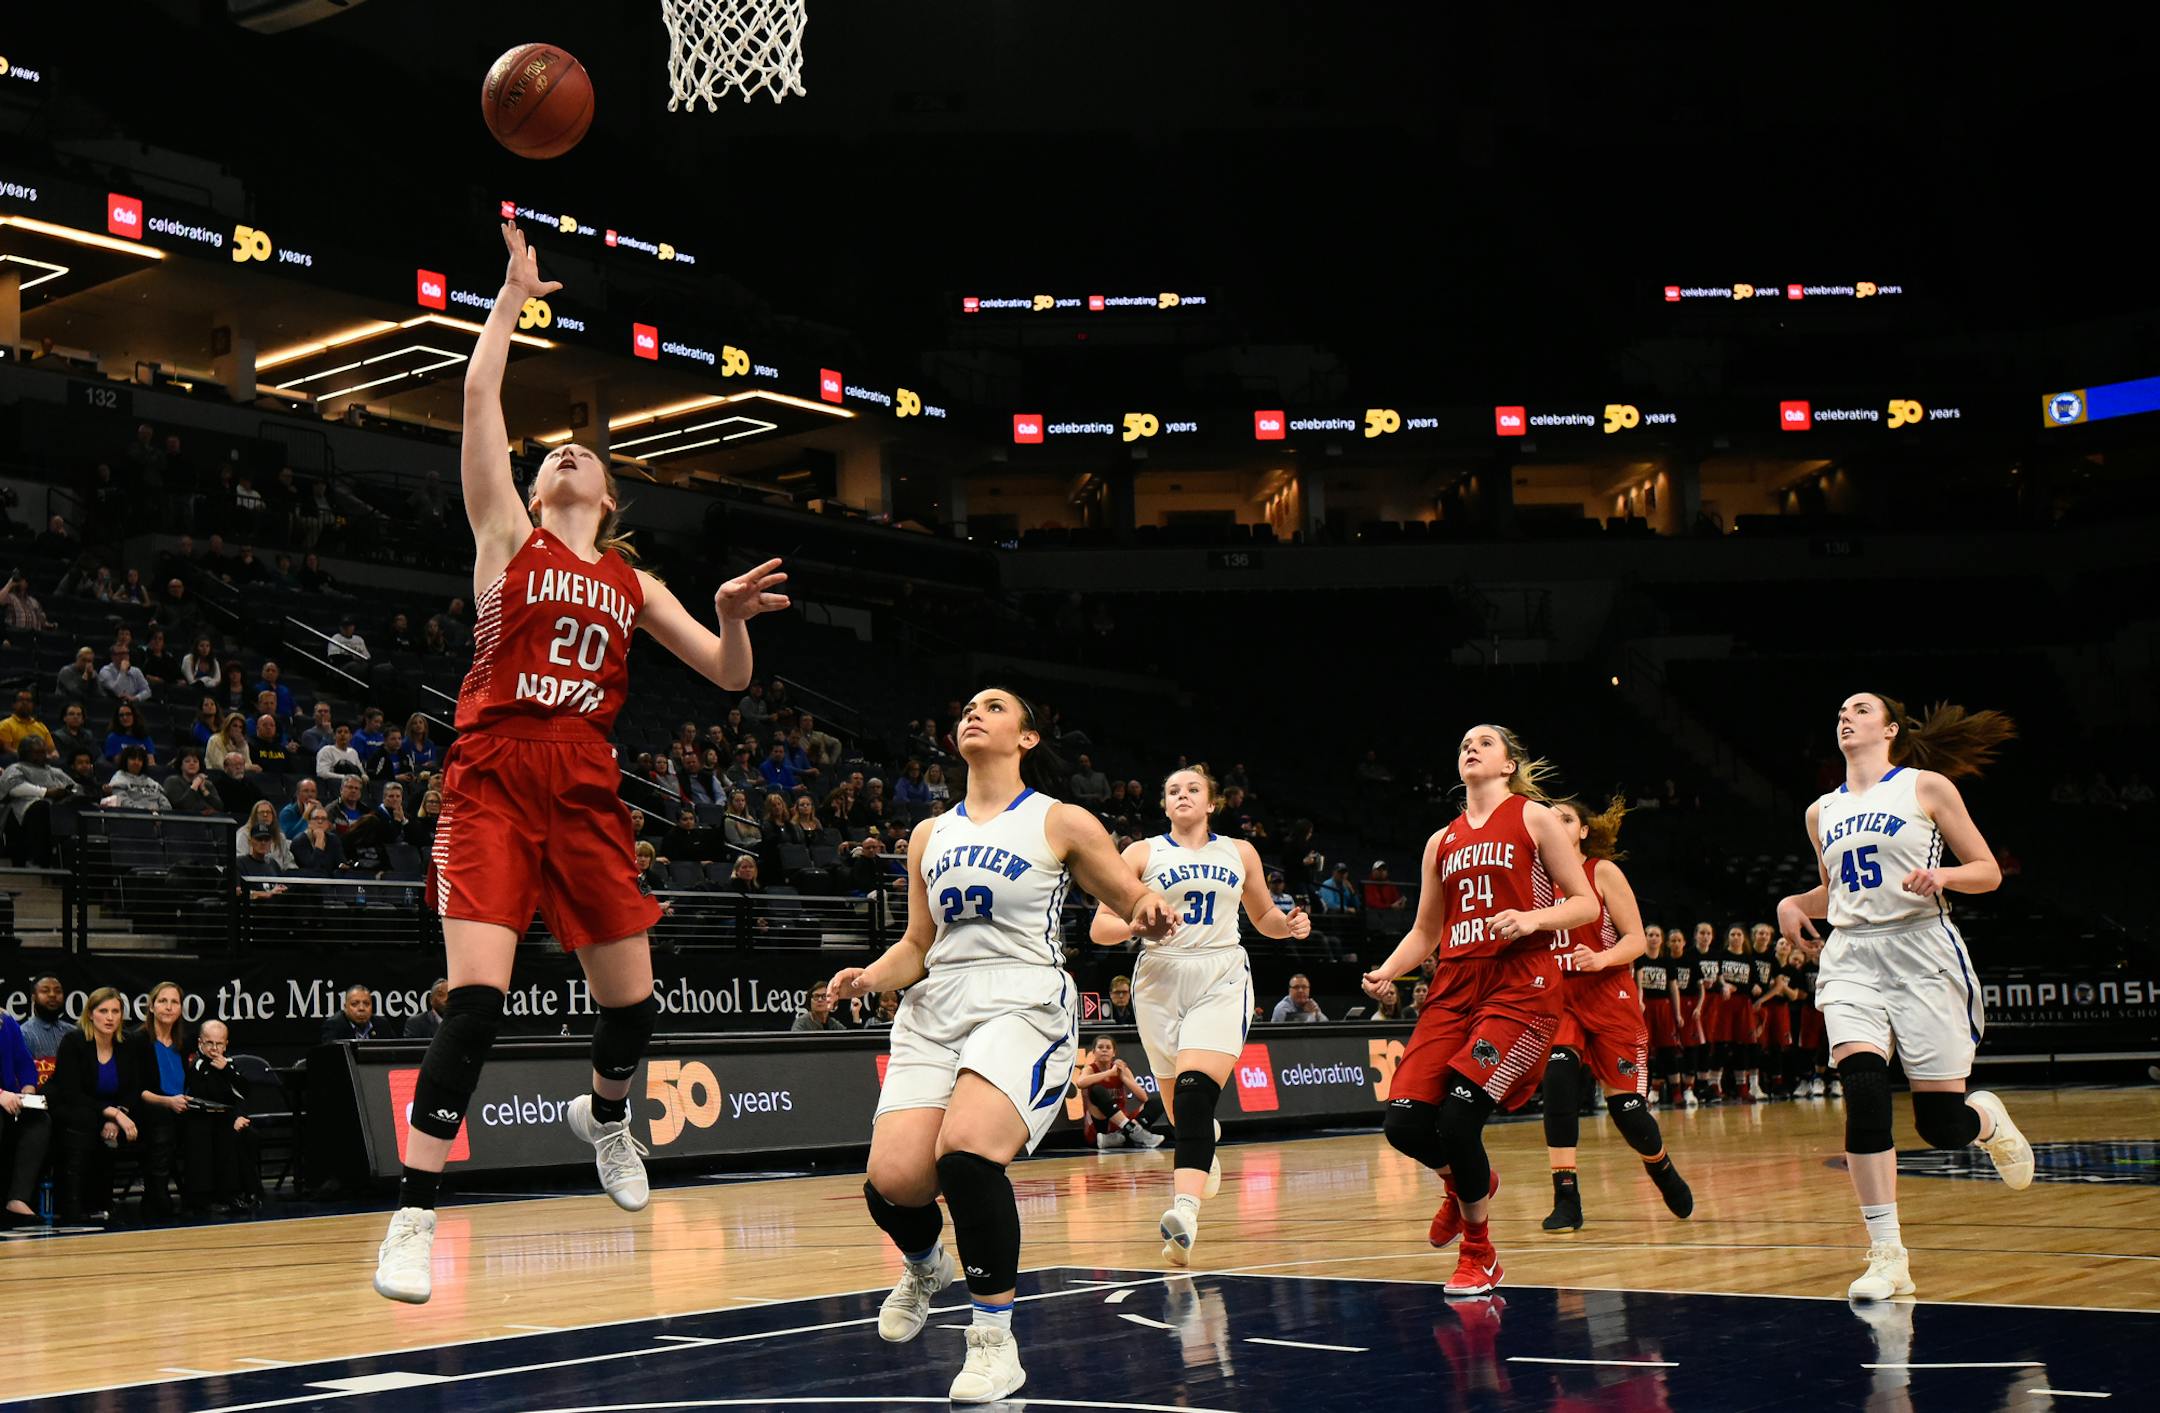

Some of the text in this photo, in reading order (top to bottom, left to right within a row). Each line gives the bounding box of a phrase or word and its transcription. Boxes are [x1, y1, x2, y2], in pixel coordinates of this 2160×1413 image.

[11, 66, 39, 82] years
[0, 181, 37, 201] years
[113, 207, 312, 266] Cub celebrating 50 years
[617, 236, 658, 255] celebrating
[657, 243, 675, 260] 50
[676, 253, 695, 264] years
[980, 299, 1032, 308] celebrating
[1033, 295, 1054, 311] 50
[1056, 299, 1081, 308] years
[1105, 297, 1157, 306] celebrating
[1159, 293, 1179, 309] 50
[1181, 297, 1206, 305] years
[1680, 288, 1731, 297] celebrating
[1733, 284, 1753, 300] 50
[1755, 288, 1779, 297] years
[1803, 286, 1854, 295] celebrating
[1856, 282, 1876, 298] 50
[1878, 286, 1902, 295] years
[422, 282, 441, 298] Cub
[451, 291, 499, 311] celebrat
[557, 317, 584, 331] years
[662, 342, 714, 365] celebrating
[722, 346, 750, 377] 50
[754, 365, 778, 378] years
[84, 386, 117, 409] 132
[845, 386, 890, 406] celebrating
[896, 388, 921, 417] 50
[925, 406, 946, 418] years
[1048, 422, 1113, 434] celebrating
[1123, 413, 1159, 441] 50
[1166, 423, 1197, 433] years
[1290, 418, 1355, 431] celebrating
[1365, 409, 1400, 438] 50
[1407, 418, 1438, 429] years
[1530, 414, 1594, 426] celebrating
[1604, 404, 1639, 433] 50
[1645, 414, 1676, 425] years
[1814, 409, 1878, 421] celebrating
[1888, 400, 1923, 428] 50
[1930, 409, 1960, 420] years
[1222, 553, 1250, 567] 136
[526, 568, 635, 639] LAKEVILLE
[549, 616, 610, 672] 20
[516, 672, 605, 713] NORTH
[927, 845, 1033, 890] EASTVIEW
[1442, 841, 1515, 883] LAKEVILLE
[1841, 844, 1883, 893] 45
[1157, 864, 1240, 891] EASTVIEW
[939, 885, 993, 924] 23
[1183, 890, 1217, 926] 31
[1458, 874, 1494, 913] 24
[1449, 916, 1497, 948] NORT
[217, 978, 276, 1021] the
[502, 984, 559, 1017] tate
[653, 977, 743, 1015] School
[749, 979, 809, 1018] Leag
[2072, 1009, 2110, 1020] HIGH
[2118, 1007, 2158, 1019] SCHO
[1240, 1066, 1268, 1089] Cub
[1280, 1060, 1365, 1088] celebrating
[646, 1059, 722, 1146] 50
[729, 1088, 794, 1120] years
